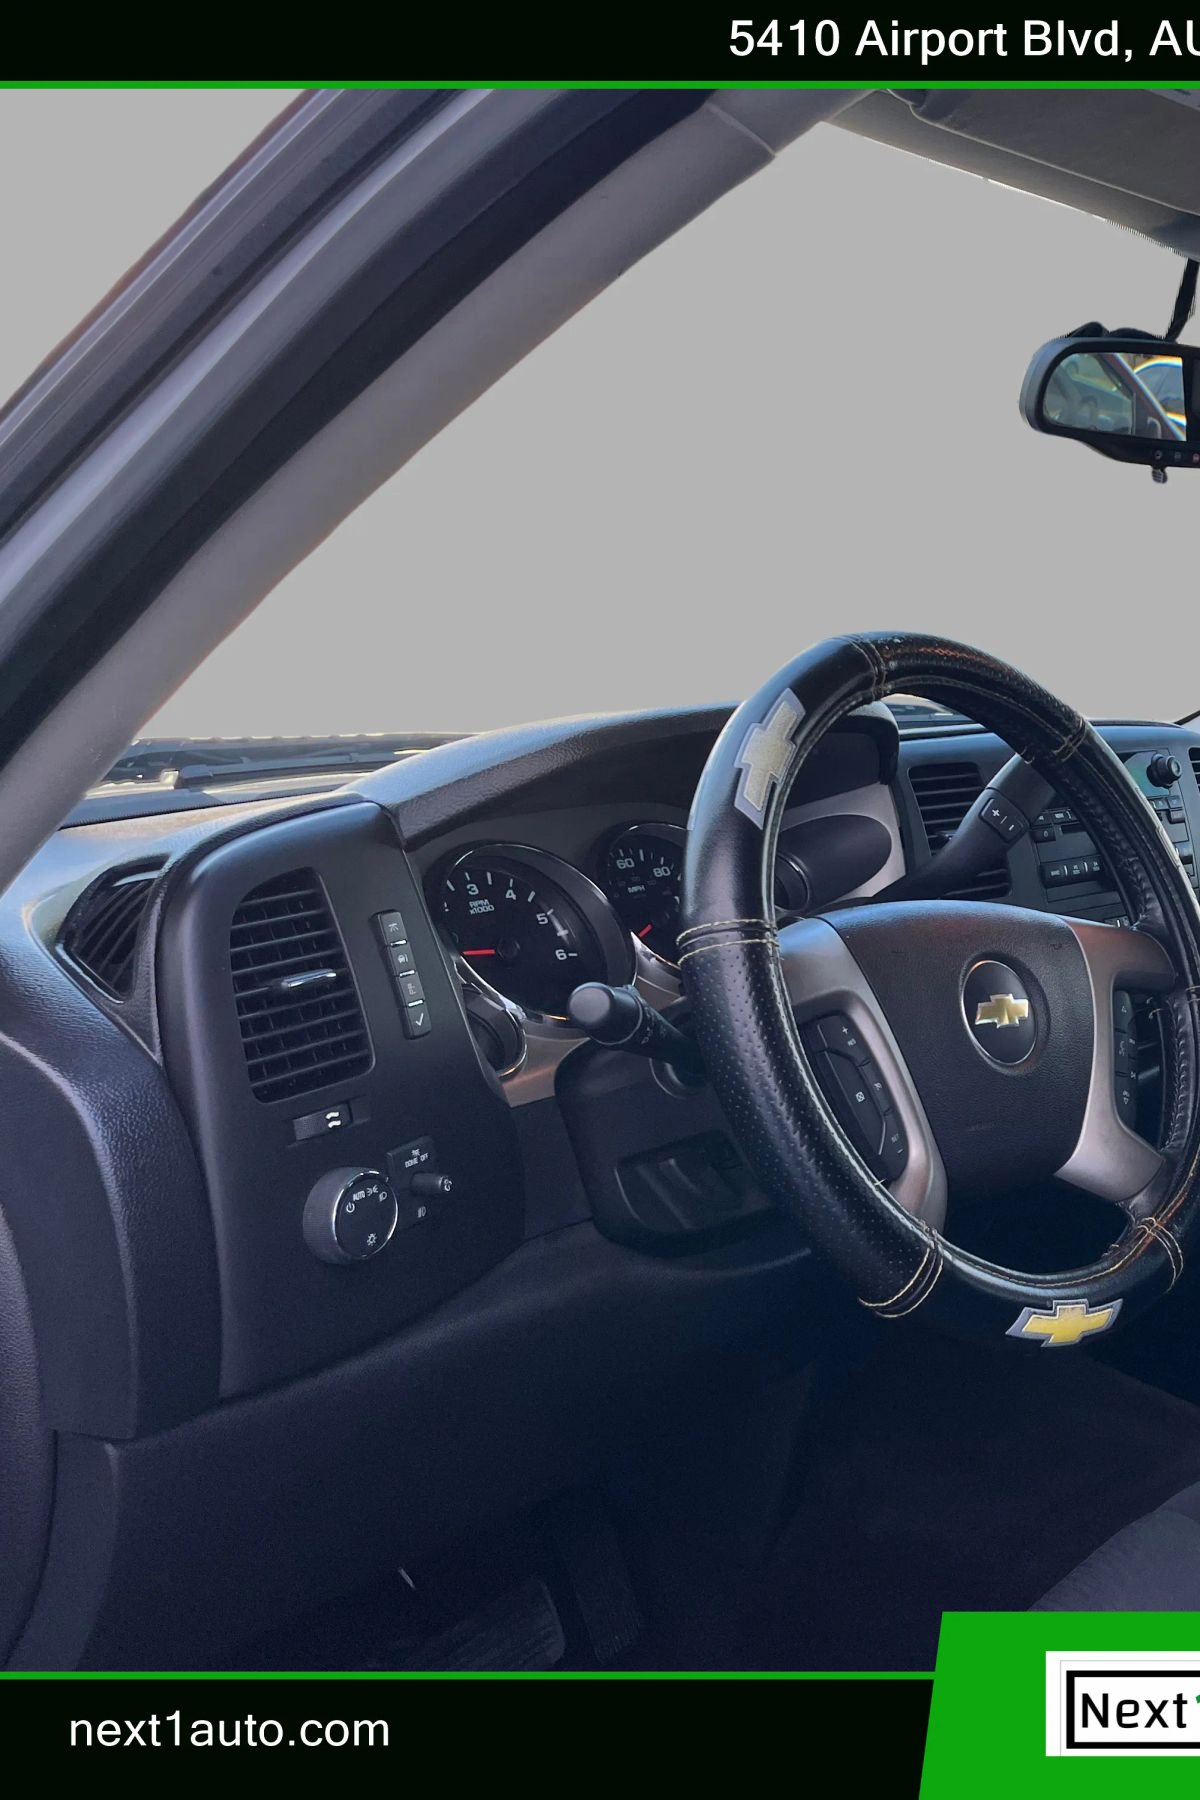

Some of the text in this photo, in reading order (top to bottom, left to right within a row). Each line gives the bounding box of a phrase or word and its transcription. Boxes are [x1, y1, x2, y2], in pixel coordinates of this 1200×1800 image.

[616, 857, 636, 870] 60
[652, 866, 672, 878] 80
[466, 883, 479, 896] 3
[505, 889, 517, 901] 4
[468, 899, 490, 909] RPM
[536, 912, 549, 925] 5
[555, 948, 567, 961] 6
